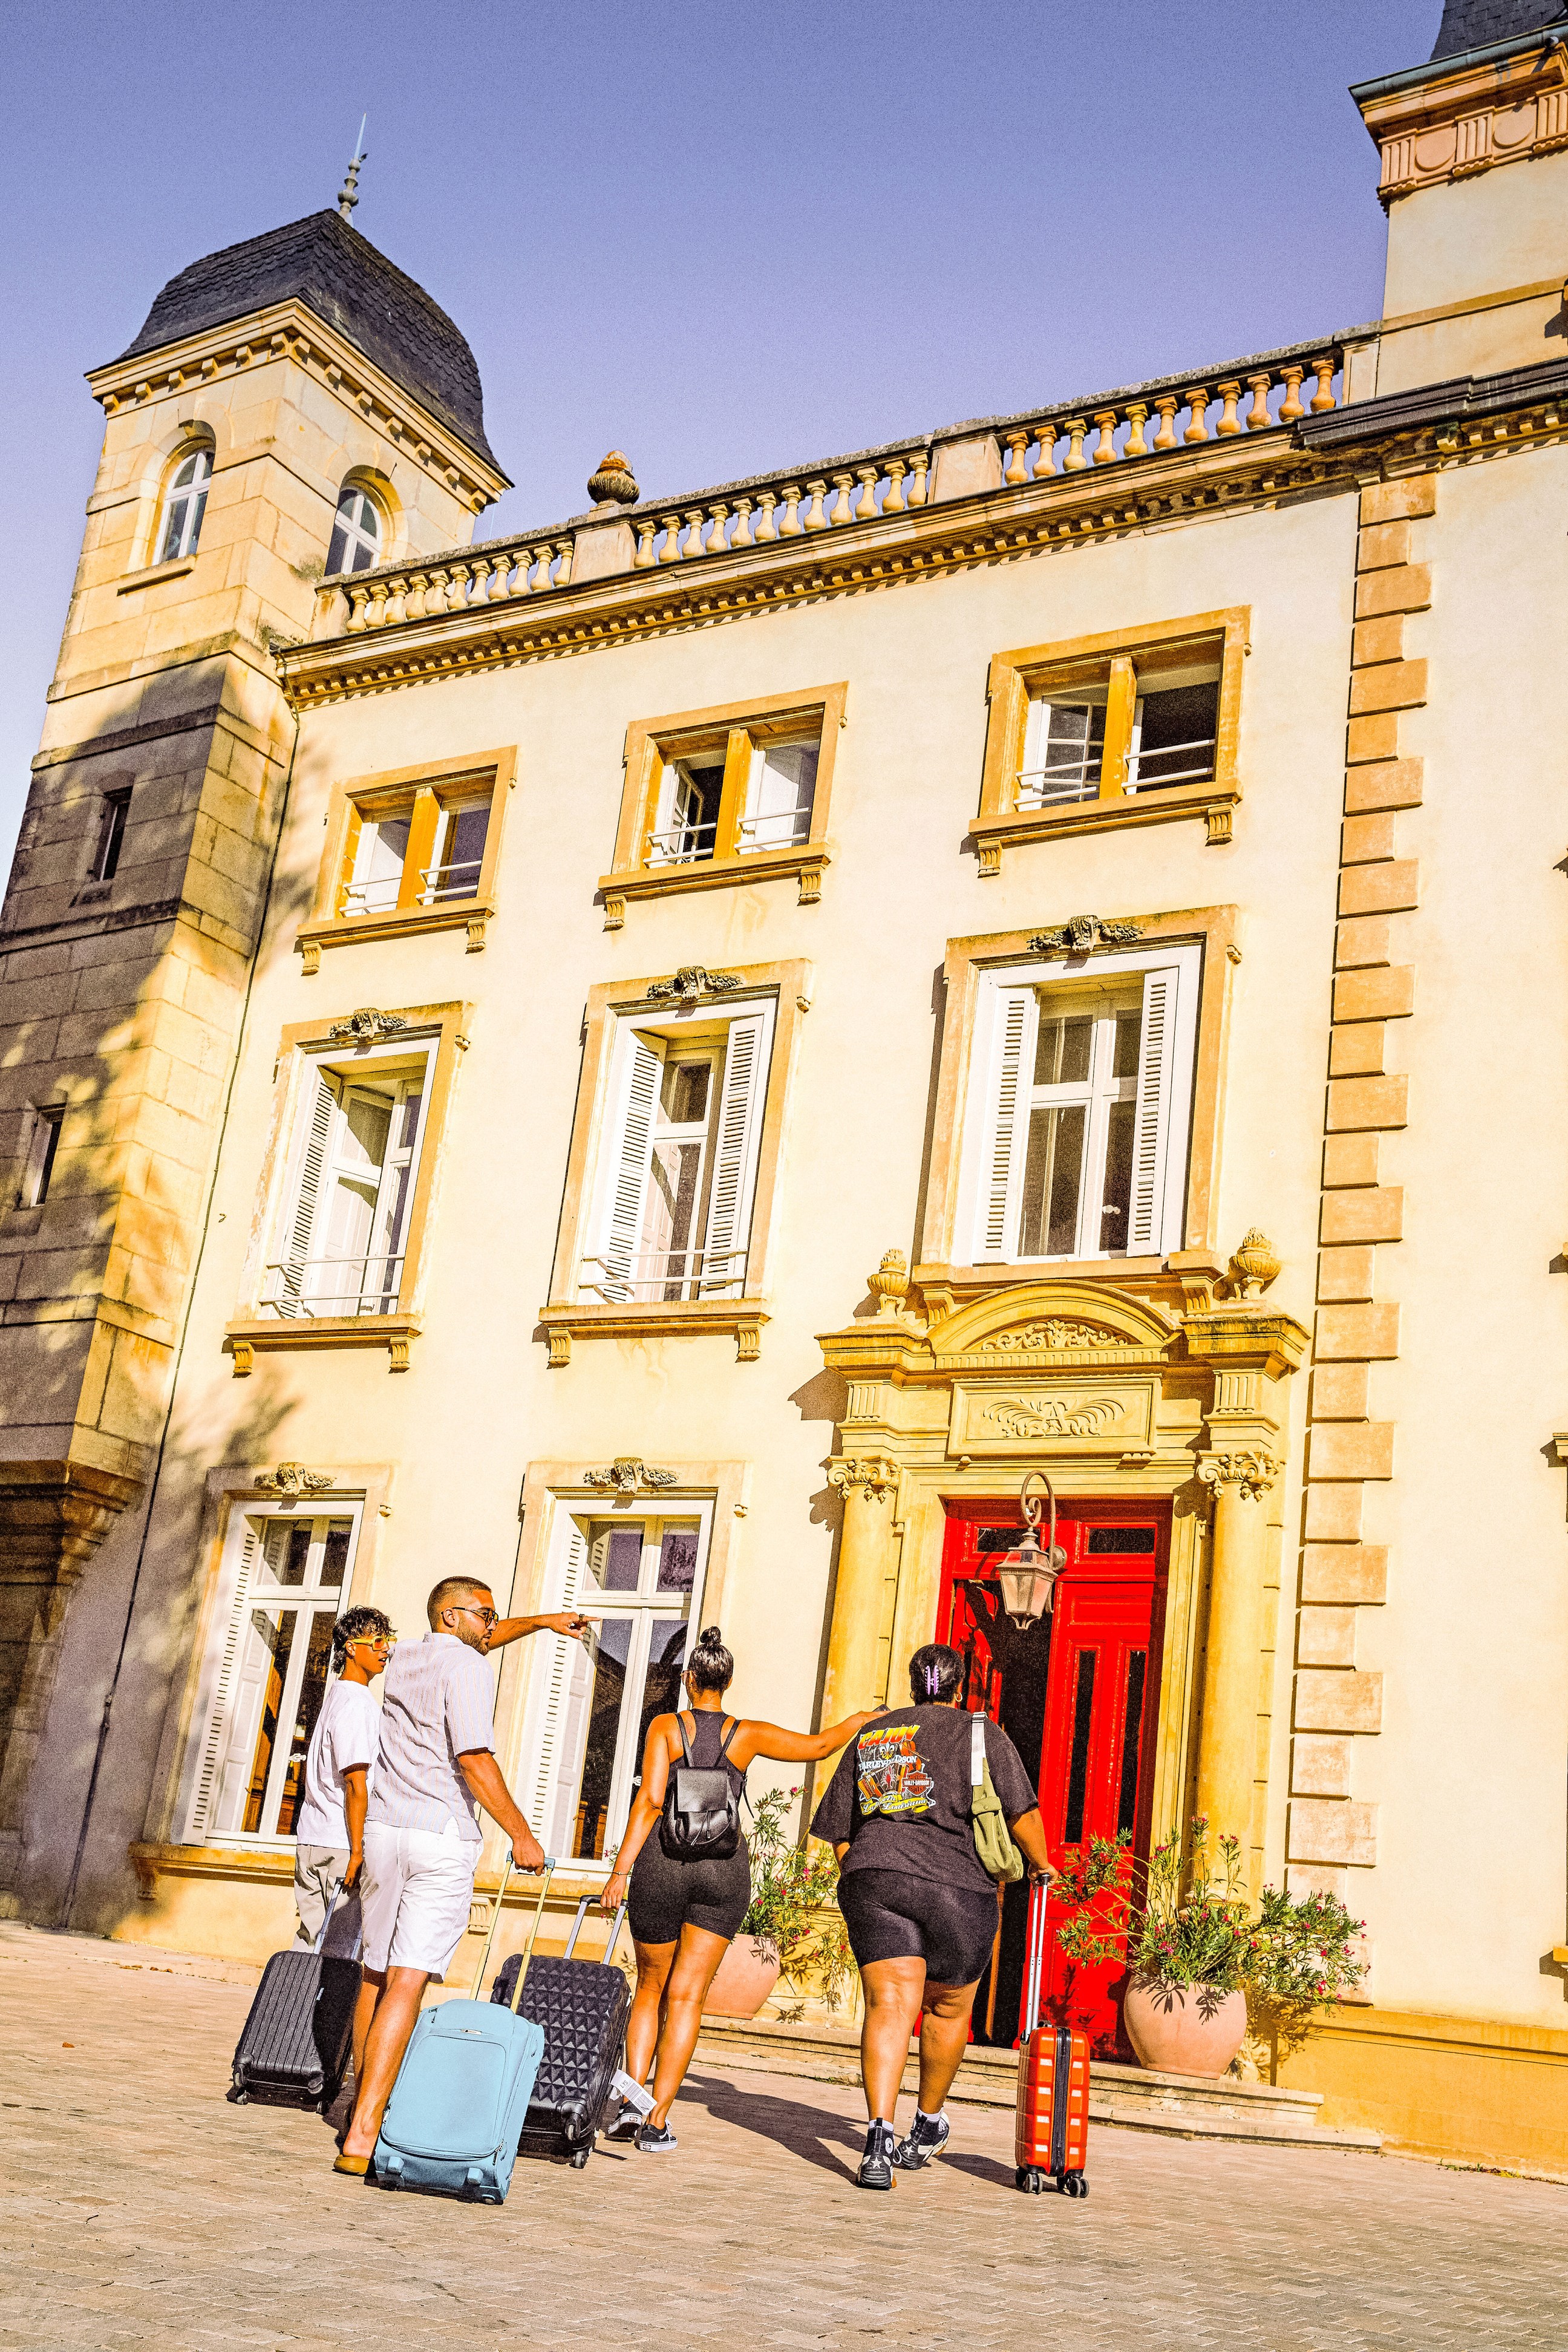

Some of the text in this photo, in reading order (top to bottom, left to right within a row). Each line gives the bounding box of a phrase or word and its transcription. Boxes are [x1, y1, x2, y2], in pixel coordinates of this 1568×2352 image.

[858, 1754, 918, 1771] ARLEY-DVIDSON
[881, 1798, 927, 1811] Louisiana
[619, 2080, 629, 2088] LYS
